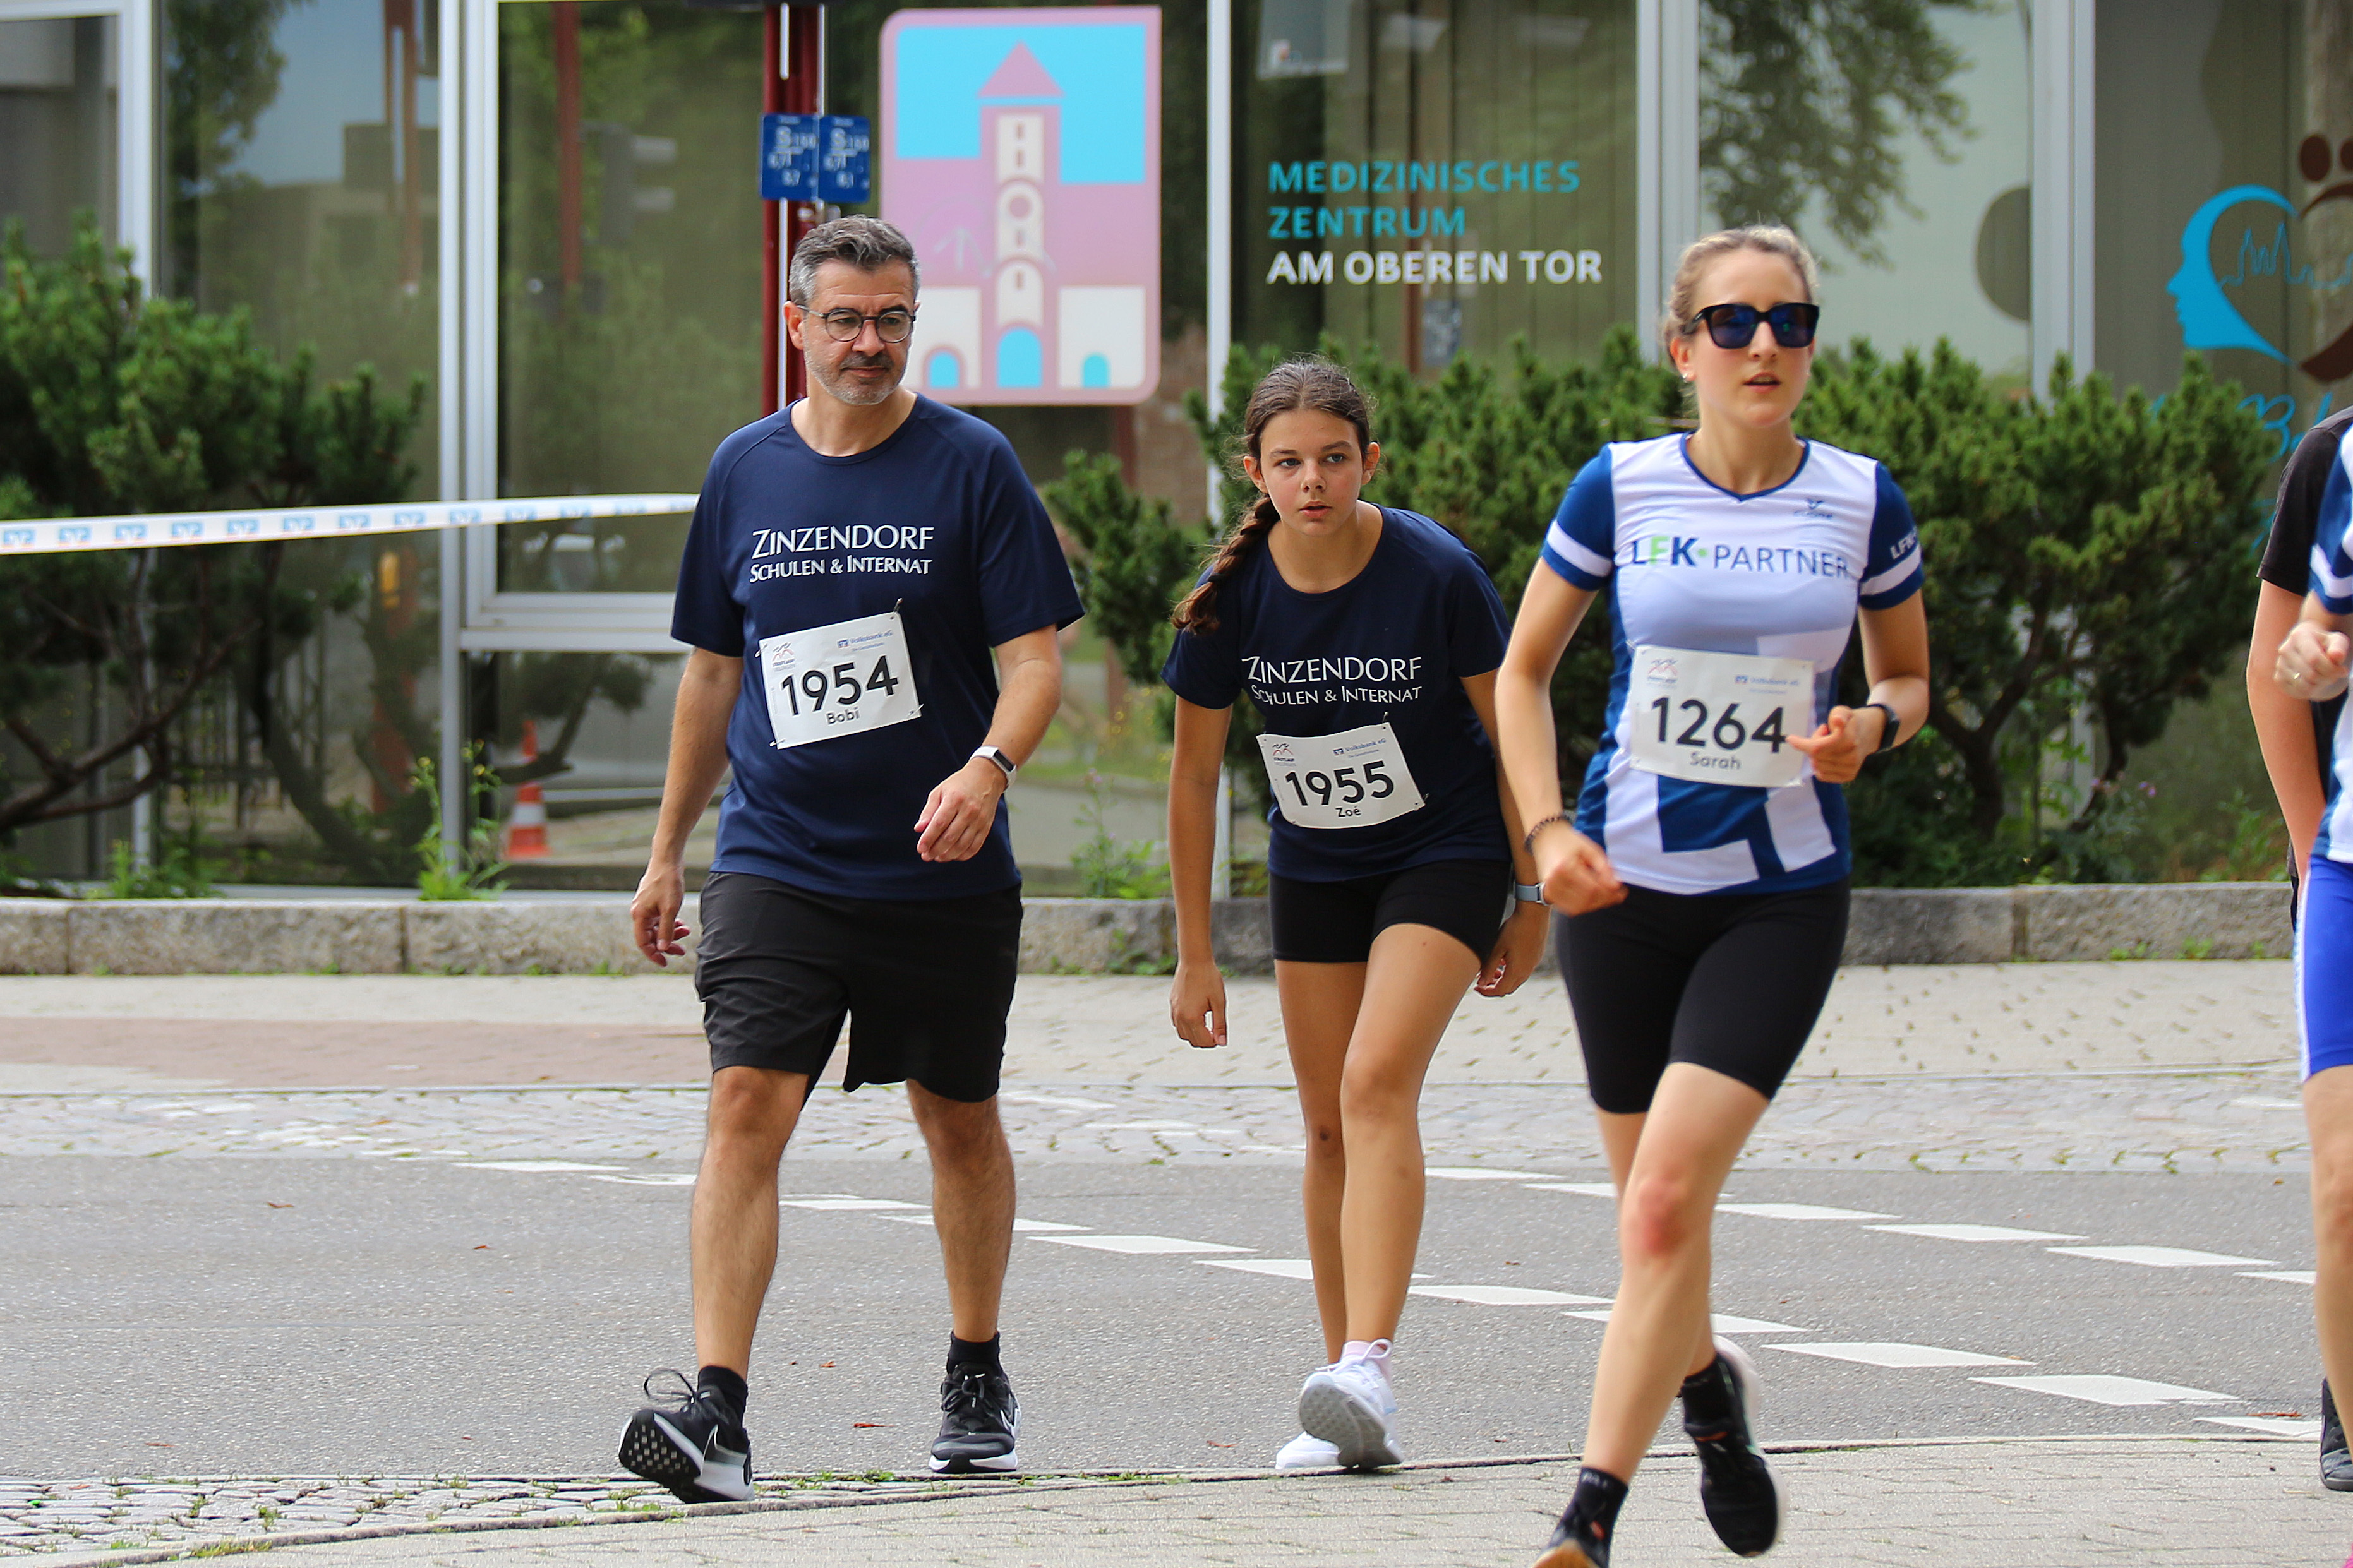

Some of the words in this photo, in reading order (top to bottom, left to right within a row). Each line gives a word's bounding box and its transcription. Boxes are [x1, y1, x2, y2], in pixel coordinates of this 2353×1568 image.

[1268, 160, 1579, 193] MEDIZINISCHES
[1268, 205, 1466, 239] ZENTRUM
[1266, 250, 1334, 284] AM
[1343, 250, 1508, 284] OBEREN
[1519, 249, 1603, 284] TOR
[751, 525, 935, 560] ZINZENDORF
[750, 559, 825, 583] SCHULEN
[830, 558, 843, 574] &
[847, 555, 932, 575] INTERNAT
[780, 655, 899, 716] 1954
[1241, 655, 1421, 684] ZINZENDORF
[1251, 685, 1319, 705] SCHULEN
[1325, 690, 1337, 702] &
[1342, 686, 1422, 703] INTERNAT
[826, 707, 860, 725] Bobi
[1652, 697, 1787, 753] 1264
[1690, 751, 1741, 770] Sarah
[1285, 760, 1394, 806] 1955
